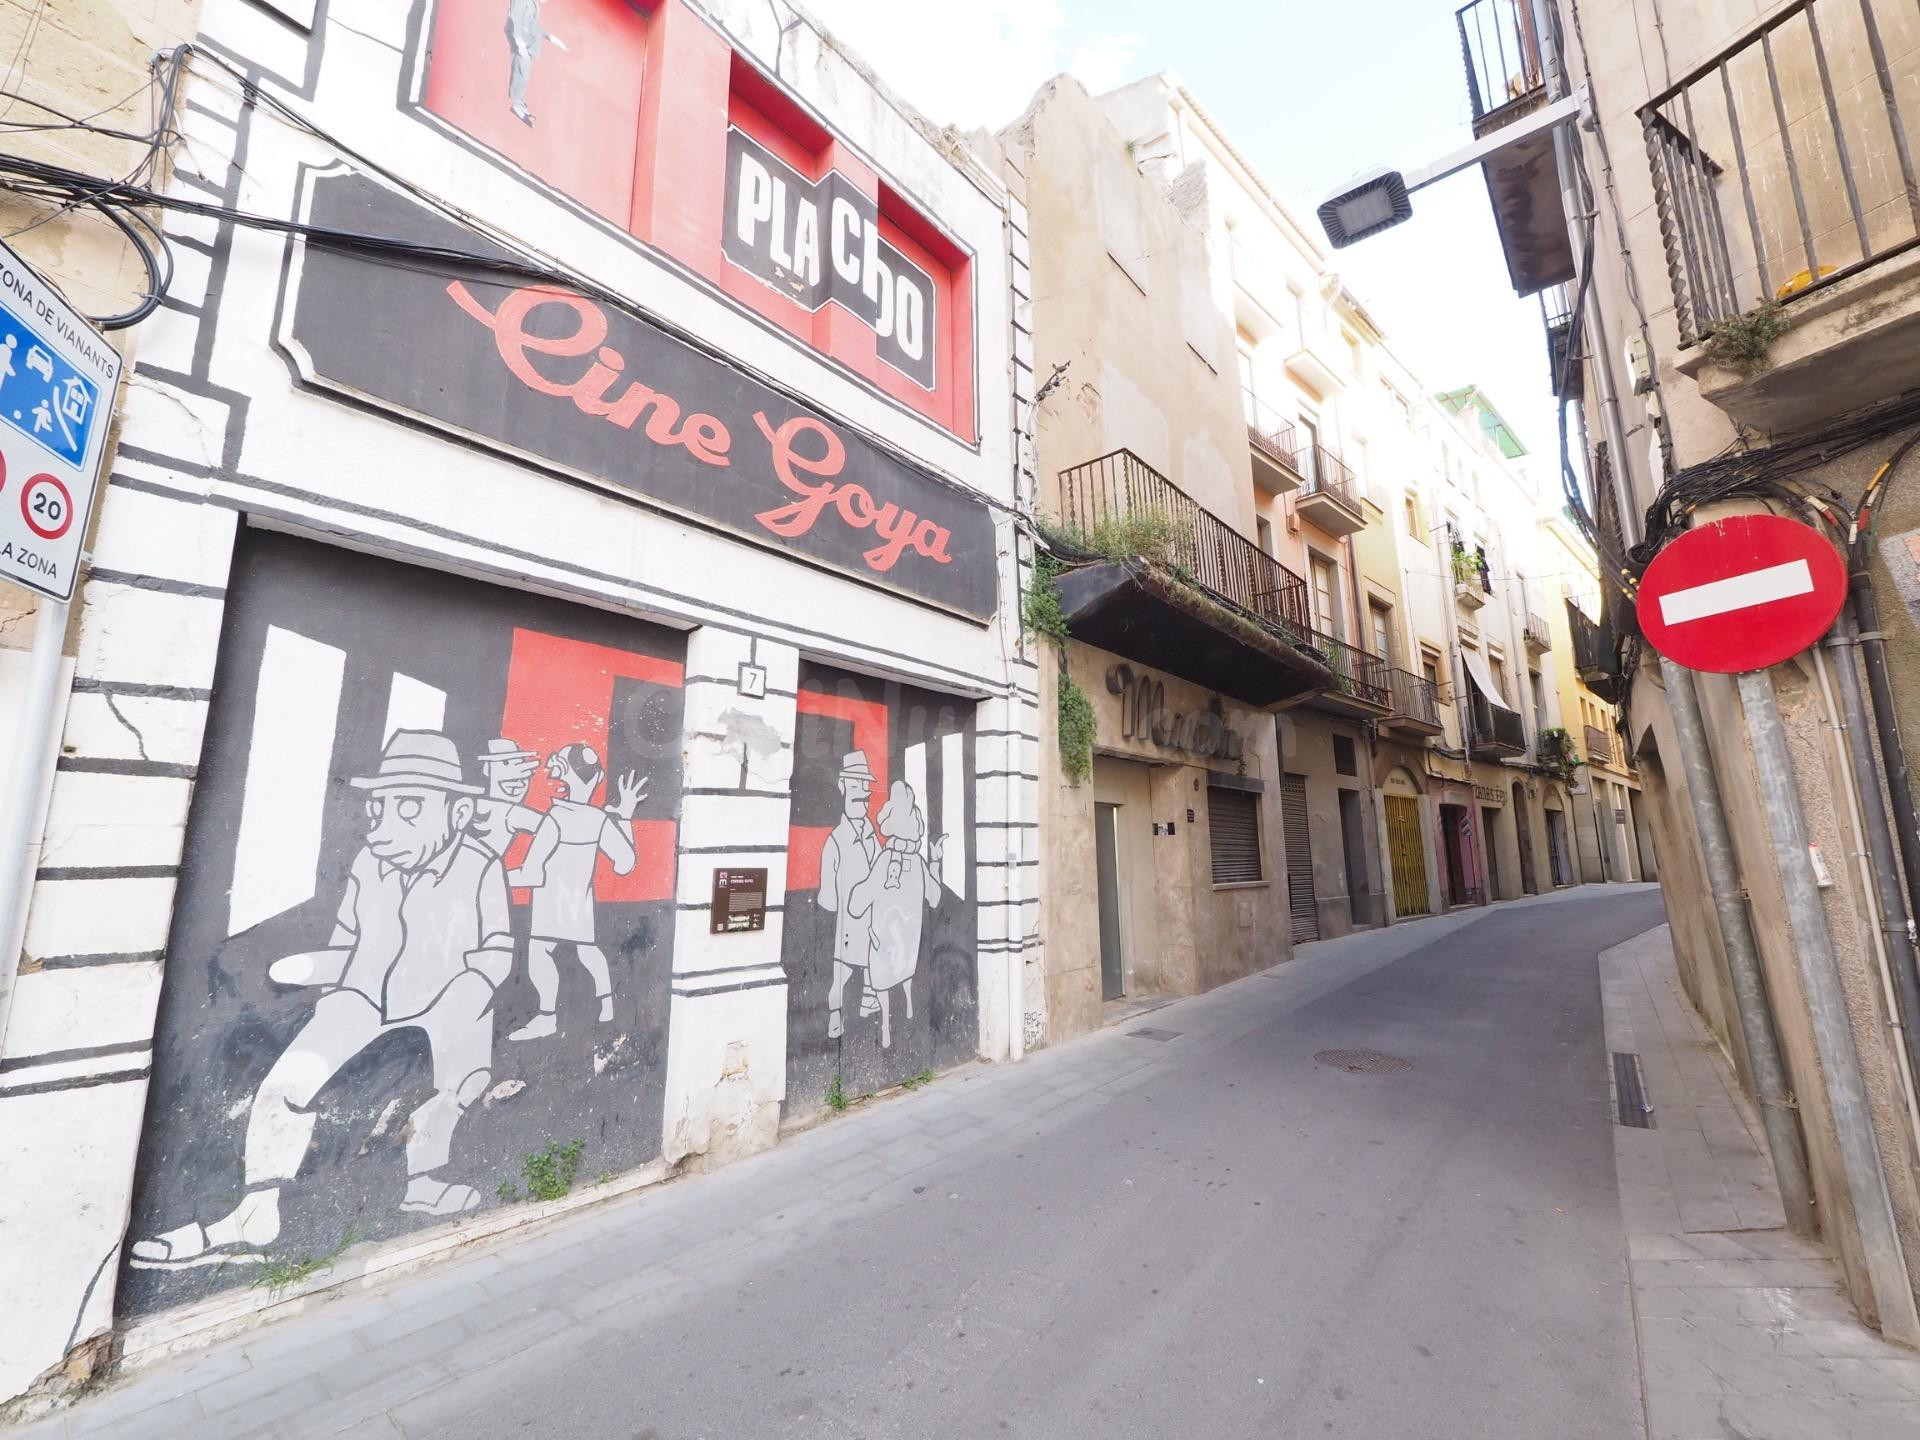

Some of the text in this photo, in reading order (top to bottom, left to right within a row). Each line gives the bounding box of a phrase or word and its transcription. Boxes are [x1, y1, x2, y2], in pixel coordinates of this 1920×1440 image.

[36, 299, 55, 326] DE
[57, 317, 115, 380] VIANANTS
[446, 279, 952, 572] Cine Goya
[33, 492, 61, 520] 20
[0, 541, 57, 579] A ZONA
[750, 672, 758, 689] 7
